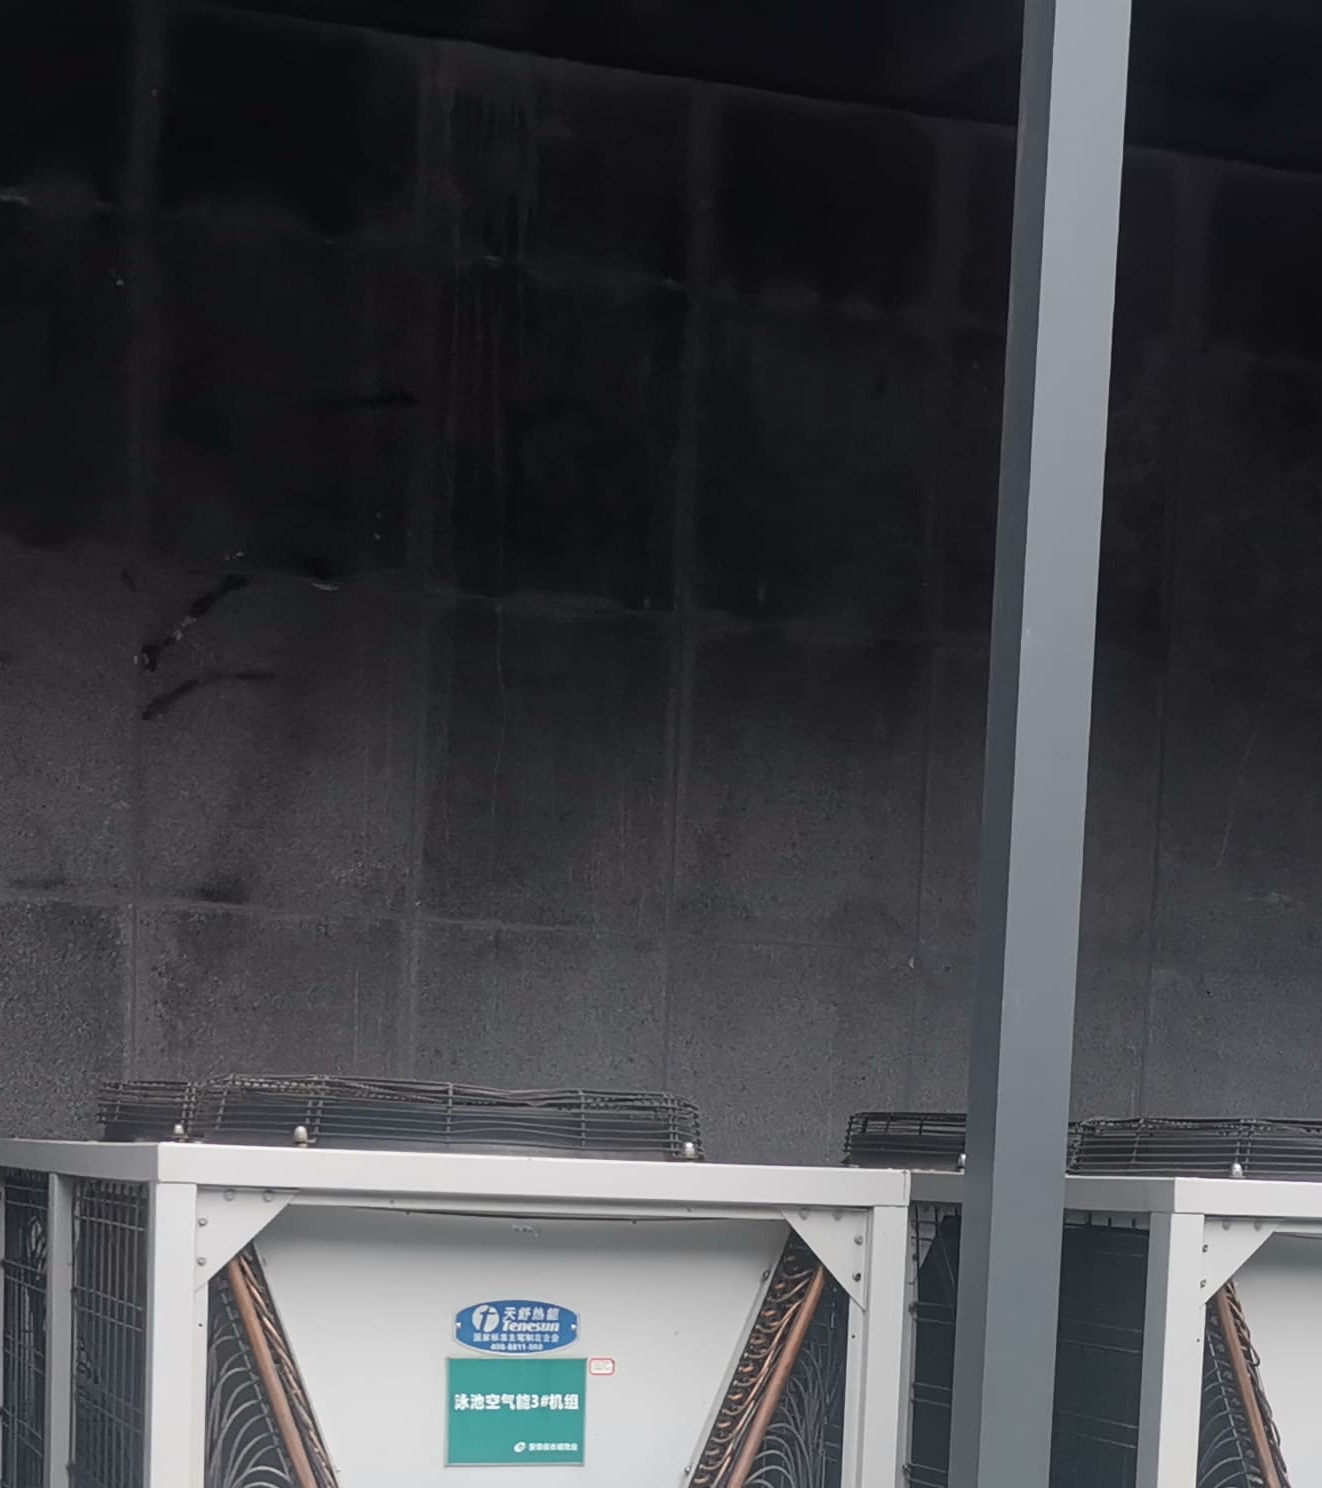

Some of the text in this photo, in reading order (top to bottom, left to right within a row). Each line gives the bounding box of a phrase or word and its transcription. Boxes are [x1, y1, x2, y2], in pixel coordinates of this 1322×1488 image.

[503, 1307, 560, 1321] 天舒热能
[502, 1320, 560, 1332] Tenesun
[454, 1394, 579, 1410] 泳池空气能3#机组
